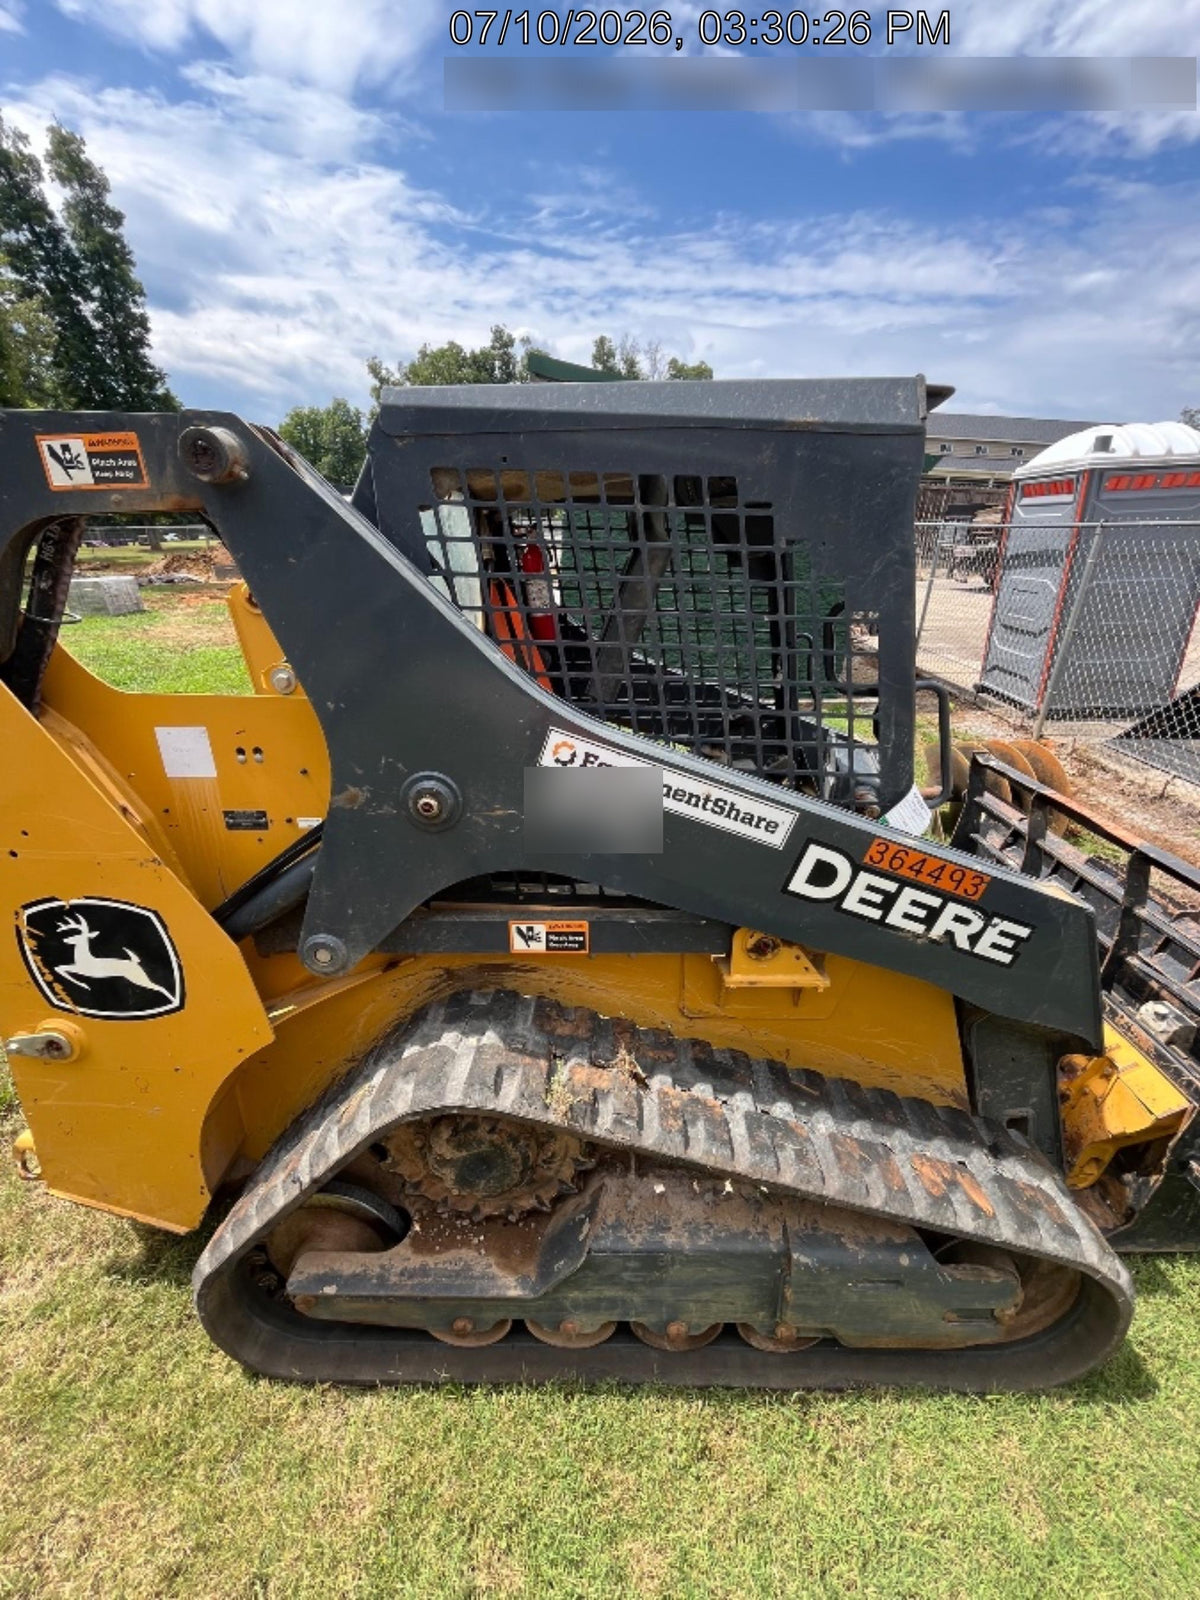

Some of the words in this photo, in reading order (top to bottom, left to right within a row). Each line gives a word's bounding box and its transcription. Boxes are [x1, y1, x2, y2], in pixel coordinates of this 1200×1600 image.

[580, 751, 780, 835] EentShare
[787, 843, 1033, 965] DEERE
[868, 842, 984, 897] 364493
